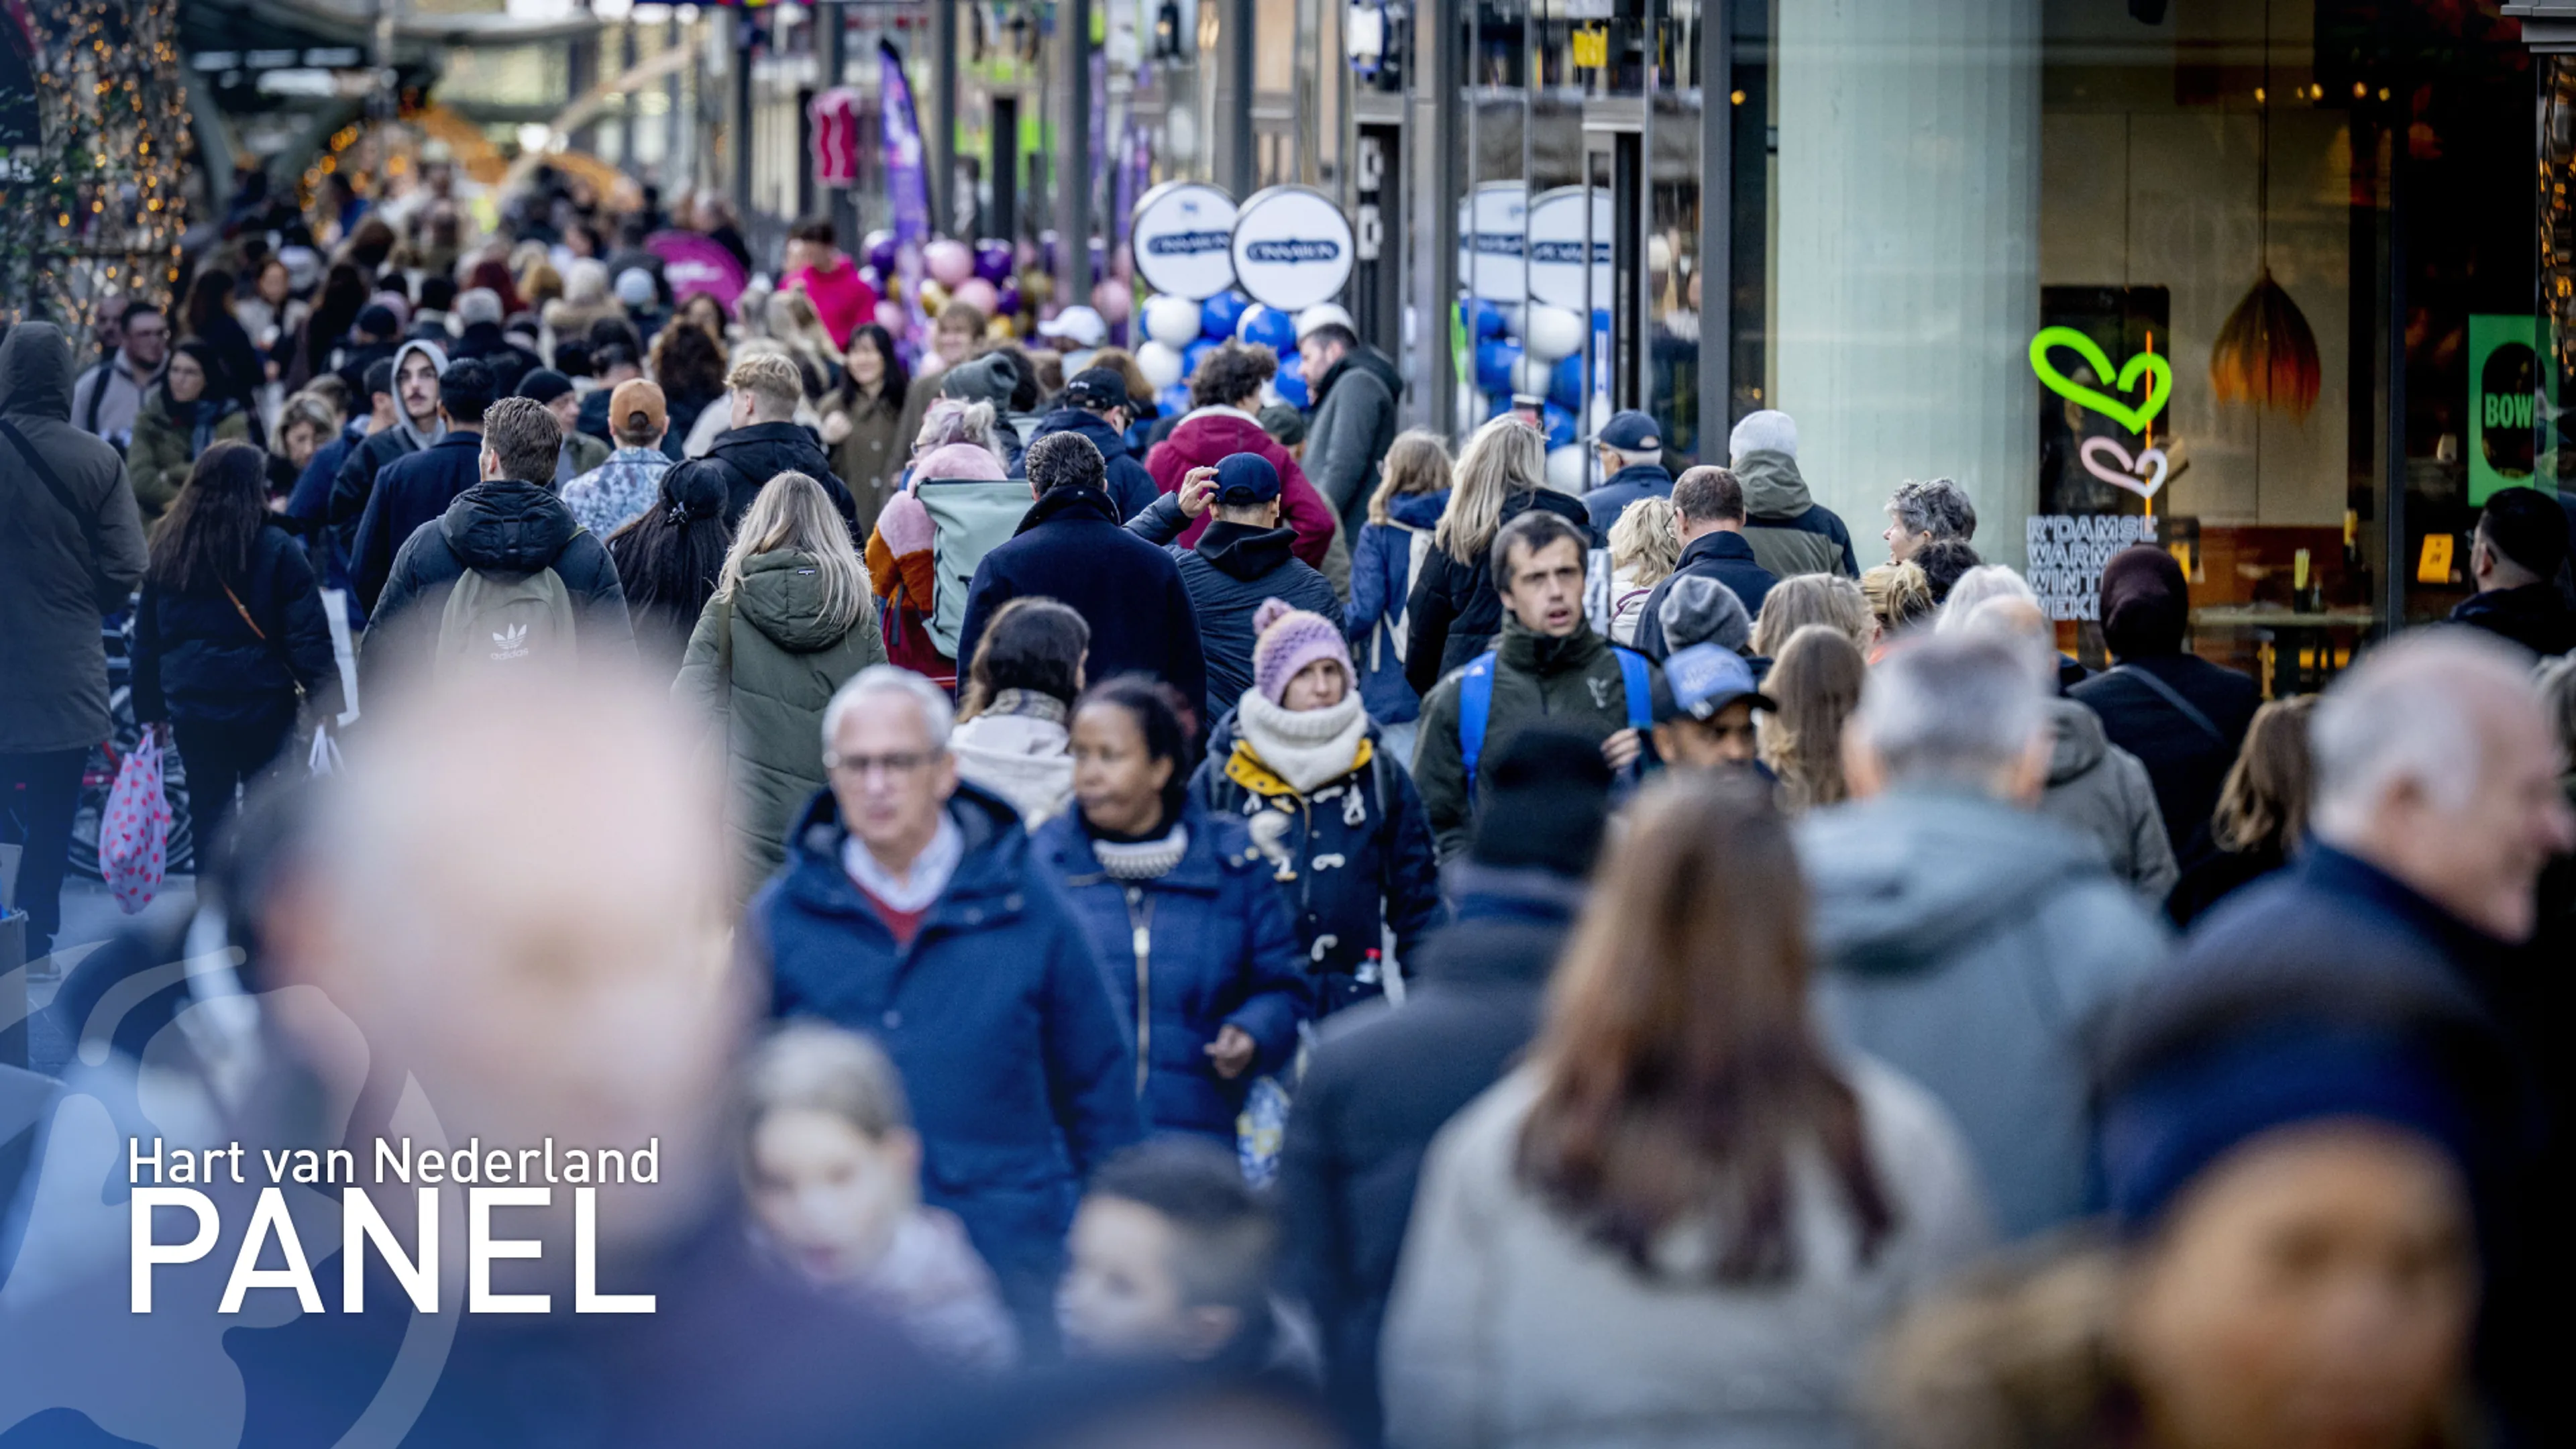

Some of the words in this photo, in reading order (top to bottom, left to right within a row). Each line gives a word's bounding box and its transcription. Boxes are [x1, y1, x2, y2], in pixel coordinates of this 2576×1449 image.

[2027, 515, 2158, 542] R'DAMSE
[2027, 569, 2105, 594] WINT
[491, 647, 529, 660] adidas
